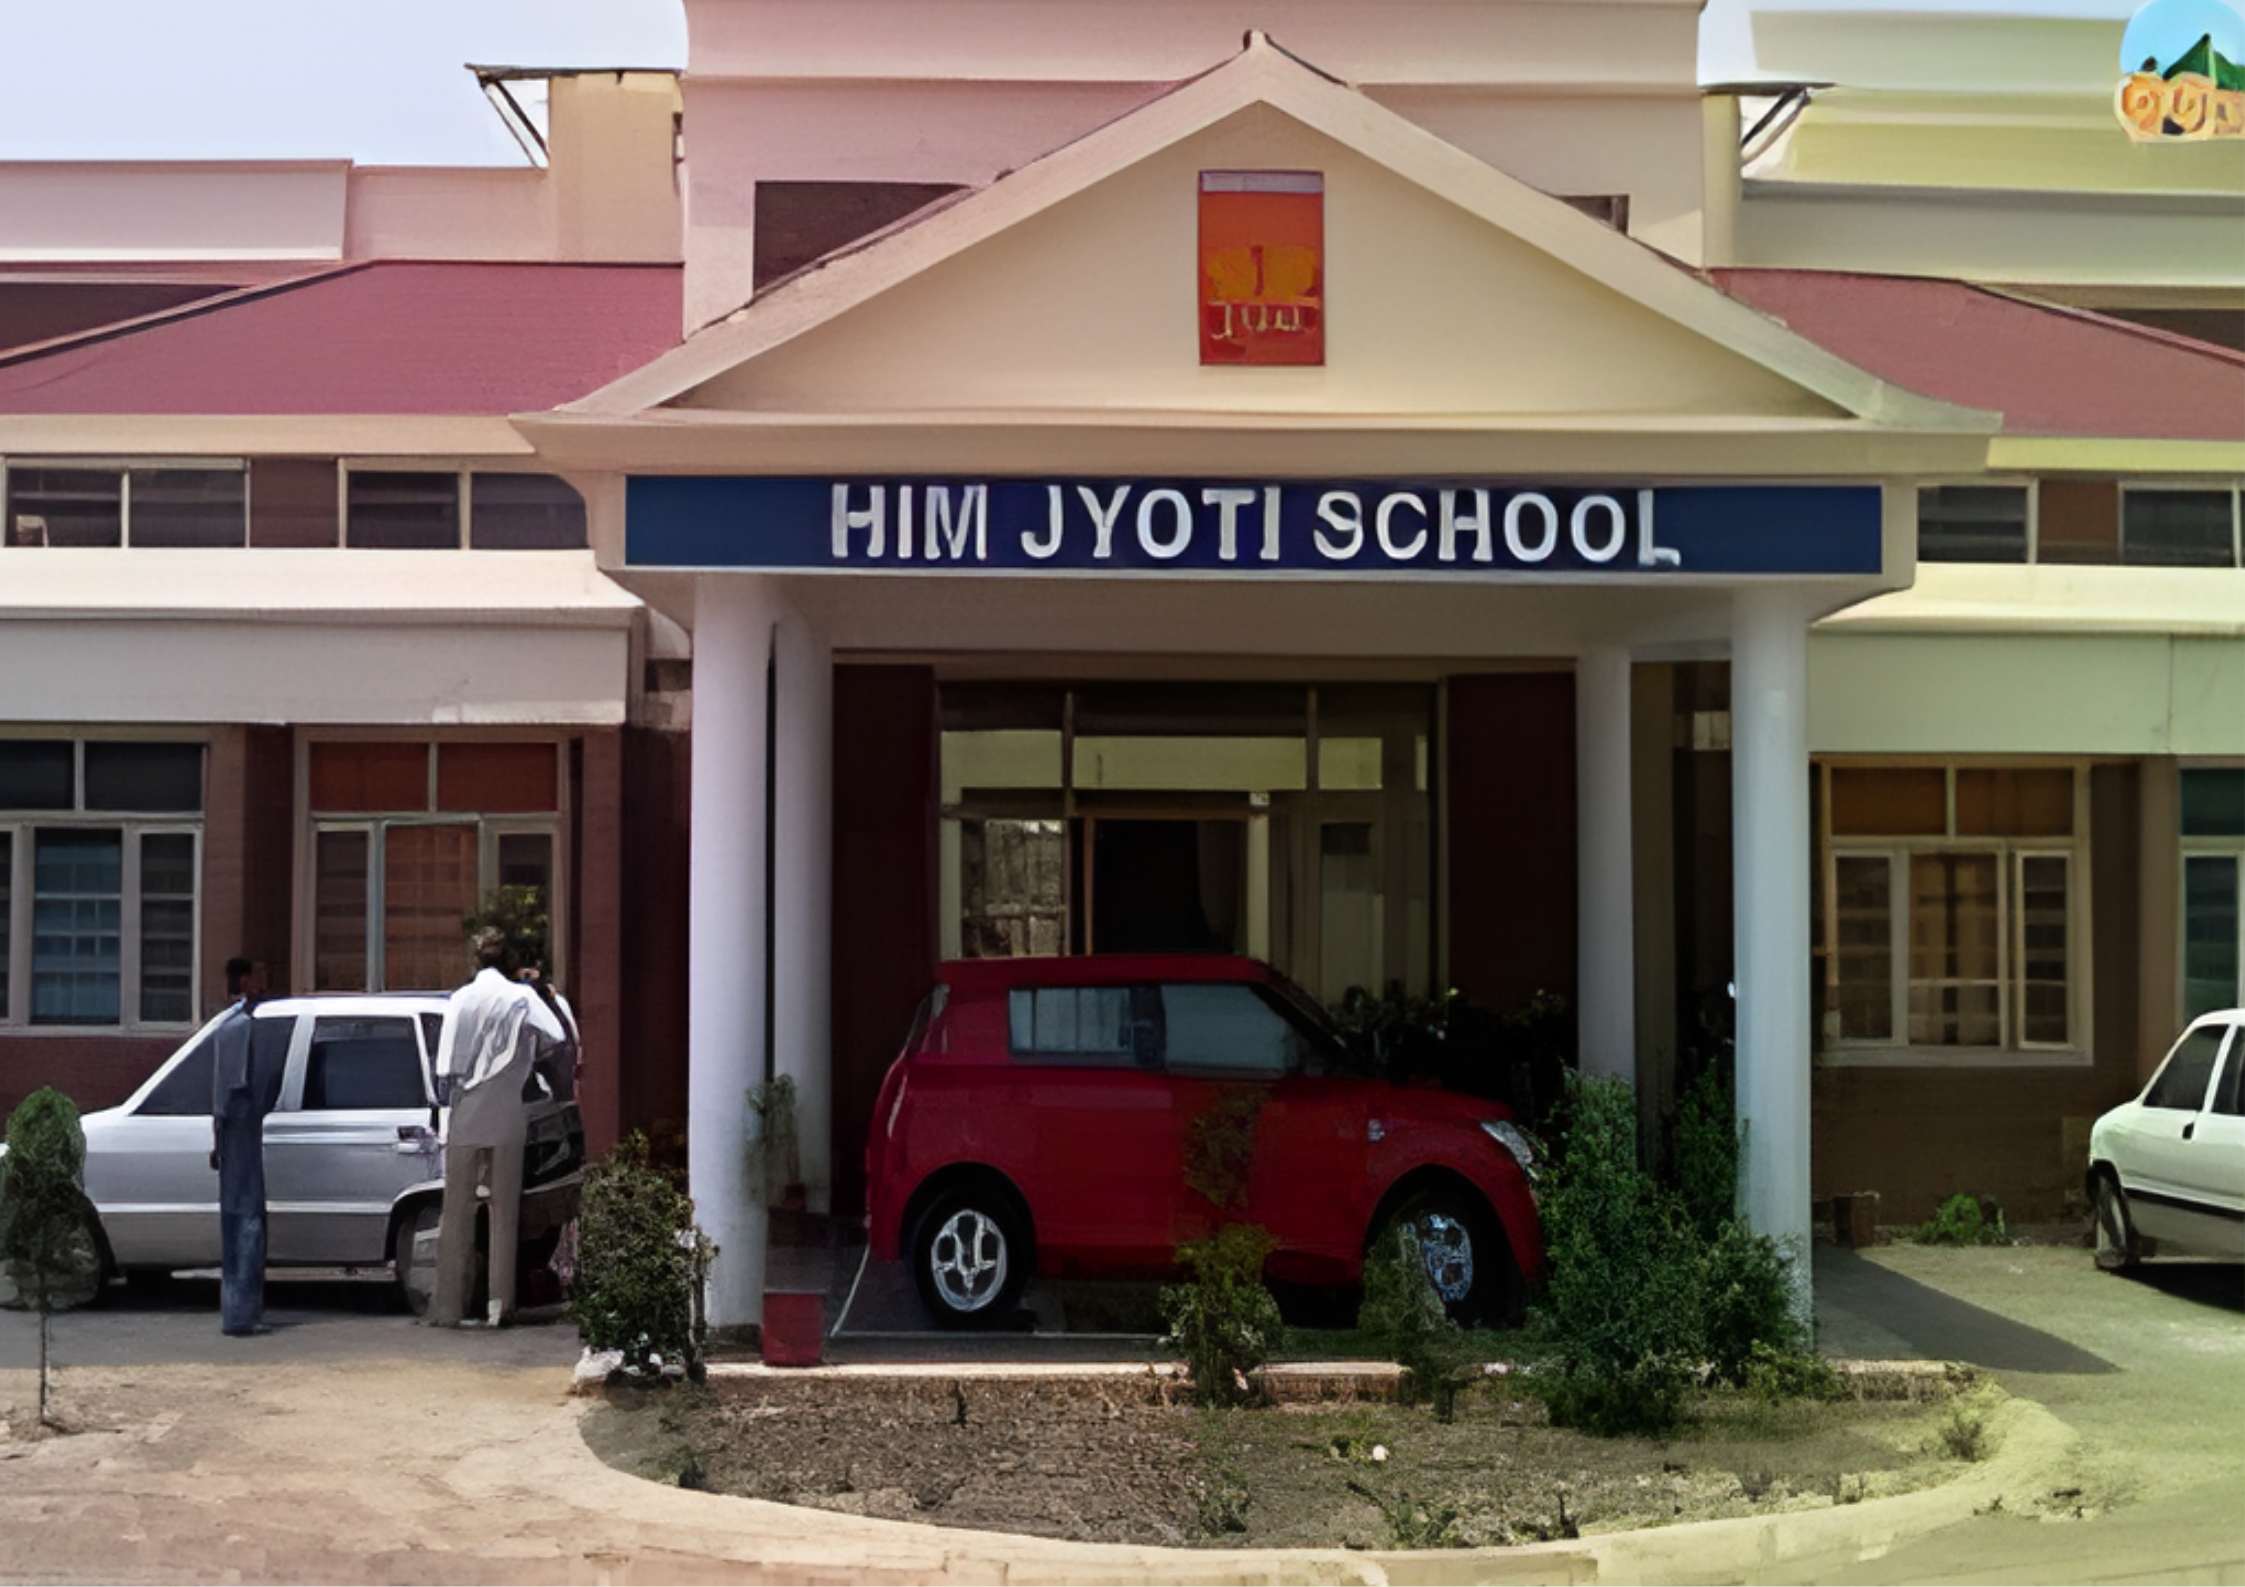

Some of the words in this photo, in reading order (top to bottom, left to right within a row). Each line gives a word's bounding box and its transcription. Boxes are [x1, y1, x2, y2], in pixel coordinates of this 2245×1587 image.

[831, 483, 987, 560] HIM
[1020, 485, 1280, 560] JYOTI
[1312, 489, 1681, 566] SCHOOL
